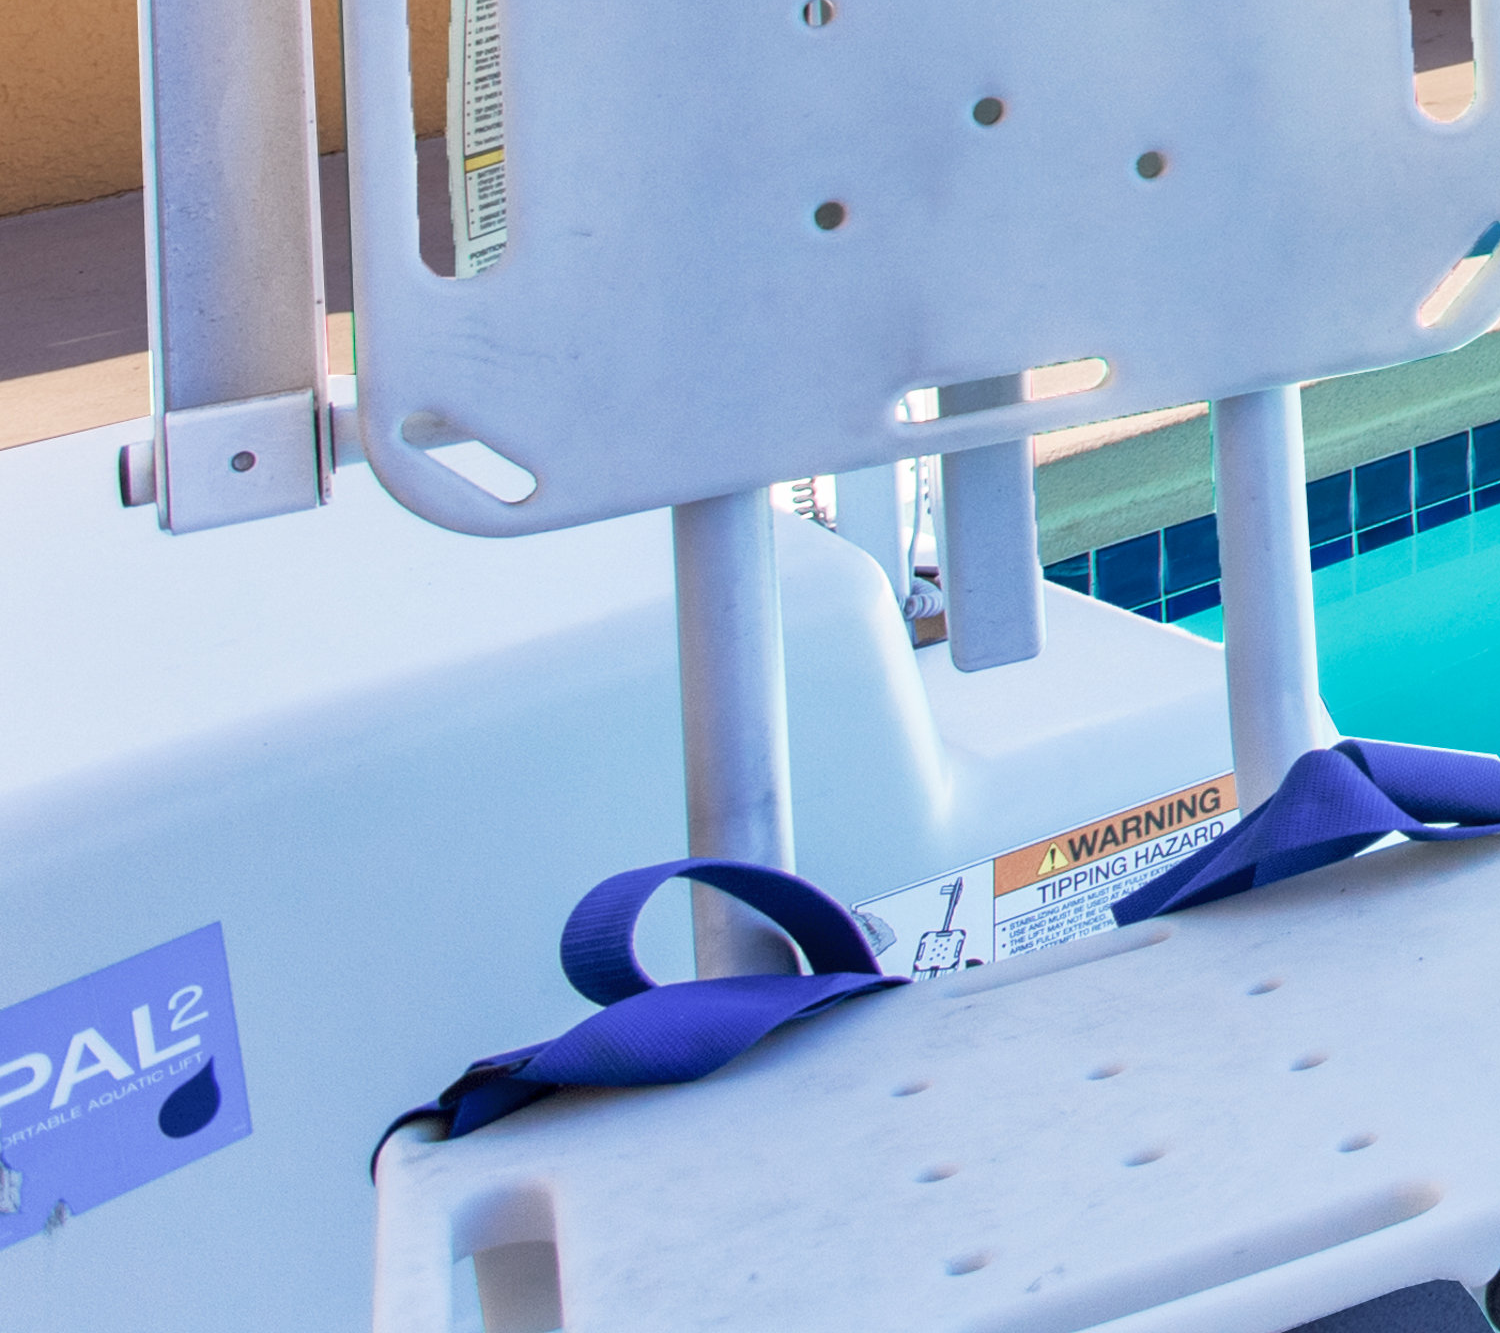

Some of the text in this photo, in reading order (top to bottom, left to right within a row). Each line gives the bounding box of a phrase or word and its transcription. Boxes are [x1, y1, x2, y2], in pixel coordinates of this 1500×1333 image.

[1067, 786, 1222, 862] WARNING
[1036, 820, 1225, 904] TIPPING HAZARD
[1009, 906, 1060, 931] STABILIZING
[1061, 896, 1085, 911] ARMS
[1087, 886, 1110, 900] MUST
[1112, 881, 1123, 891] BE
[1009, 927, 1026, 939] USE
[1028, 919, 1047, 931] AND
[1048, 910, 1071, 924] MUST
[1074, 905, 1084, 915] BE
[1086, 896, 1109, 909] USED
[1110, 892, 1120, 901] AT
[1010, 935, 1026, 947] THE
[1028, 928, 1045, 940] LIFT
[1047, 921, 1065, 933] MAY
[1067, 913, 1083, 925] NOT
[1086, 909, 1096, 918] BE
[1009, 941, 1034, 955] ARMS
[1036, 931, 1061, 945] FULLY
[87, 1069, 164, 1112] AQUATIC
[168, 1050, 204, 1076] LIFT
